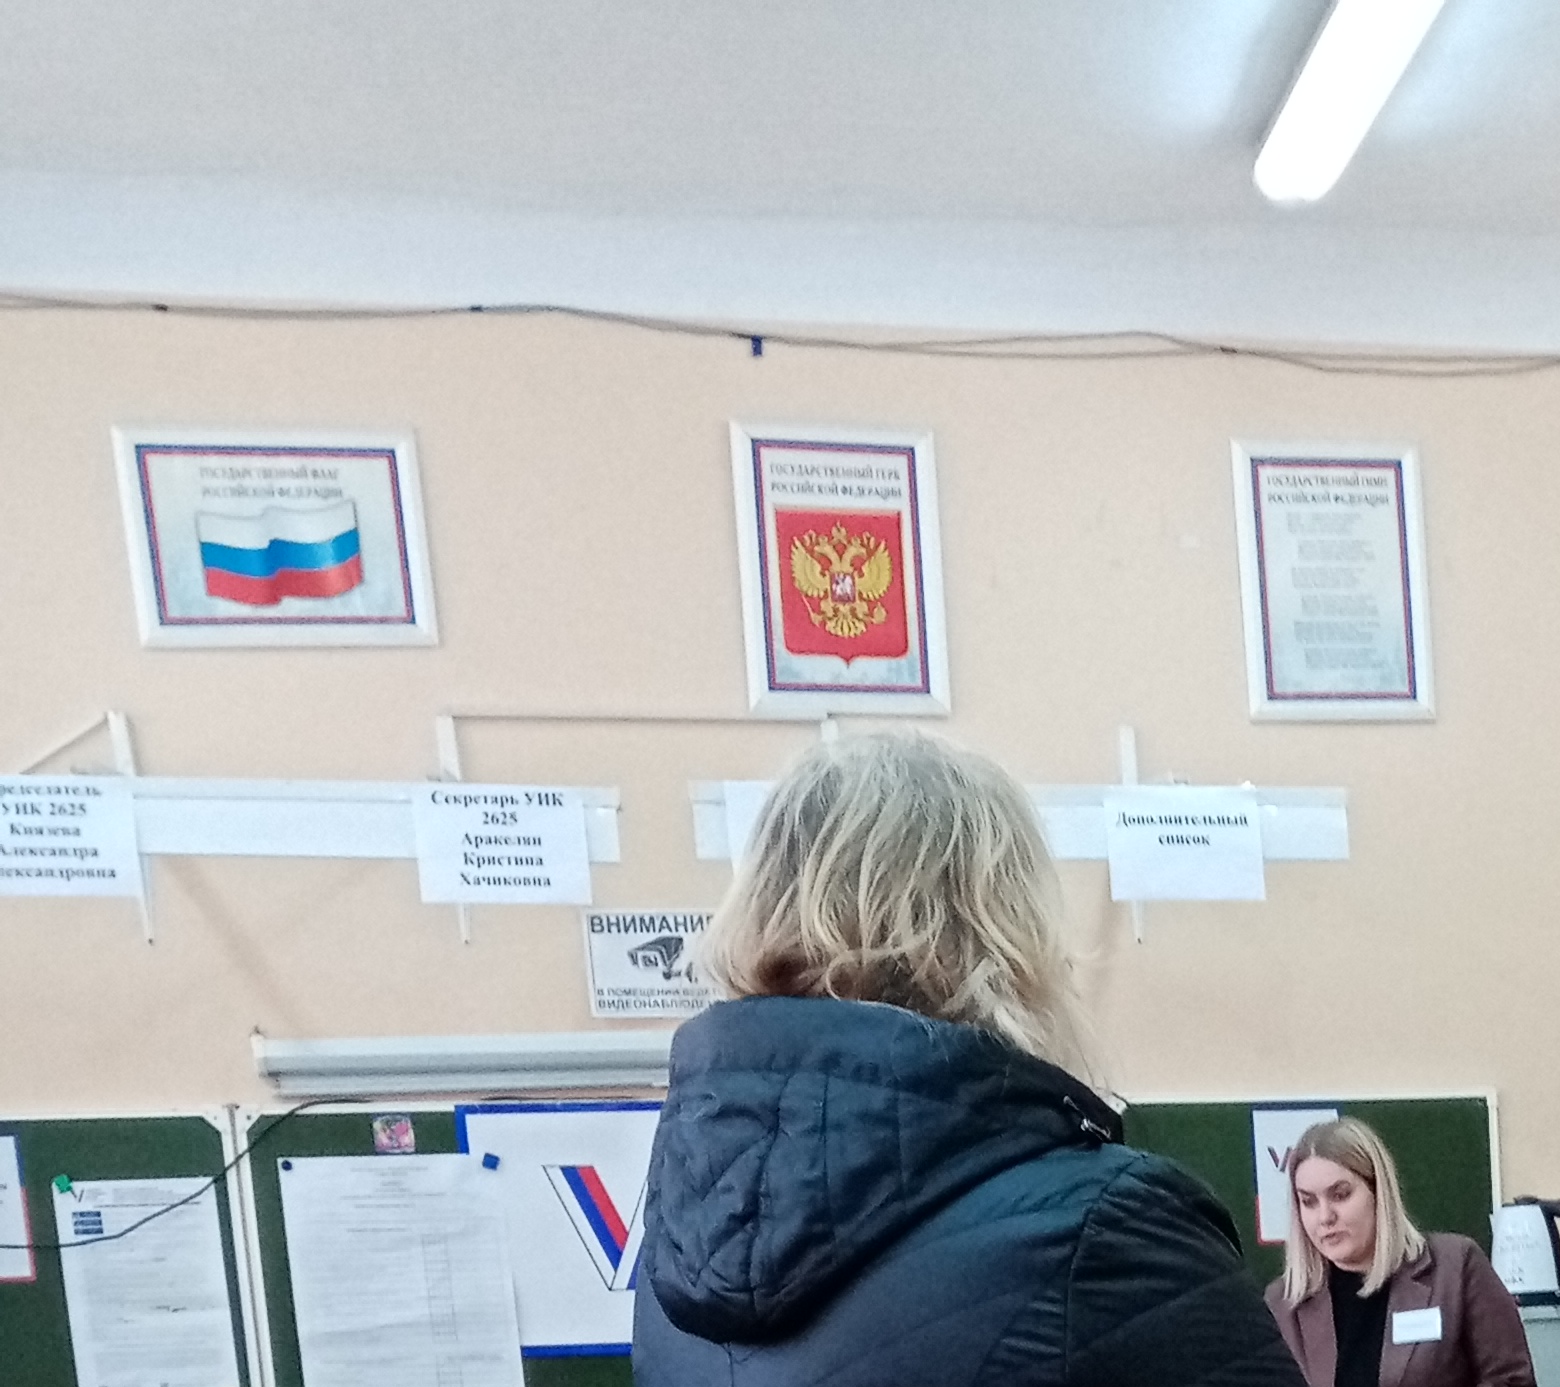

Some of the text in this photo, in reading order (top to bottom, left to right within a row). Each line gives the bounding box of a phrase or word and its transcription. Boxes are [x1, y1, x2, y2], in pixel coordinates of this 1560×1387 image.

[770, 463, 901, 481] ГОСУДАРСТВЕННЫЙ ГЕРБ
[771, 480, 902, 500] РОССИЙСКОЙ ФЕДЕРАЦИИ
[431, 790, 564, 808] Секретарь УИК
[49, 802, 87, 816] 2625
[482, 811, 519, 826] 2625
[1116, 811, 1249, 827] Дополнительный
[1158, 833, 1212, 847] список
[463, 852, 544, 868] Кристина
[460, 872, 552, 888] Хачиковна
